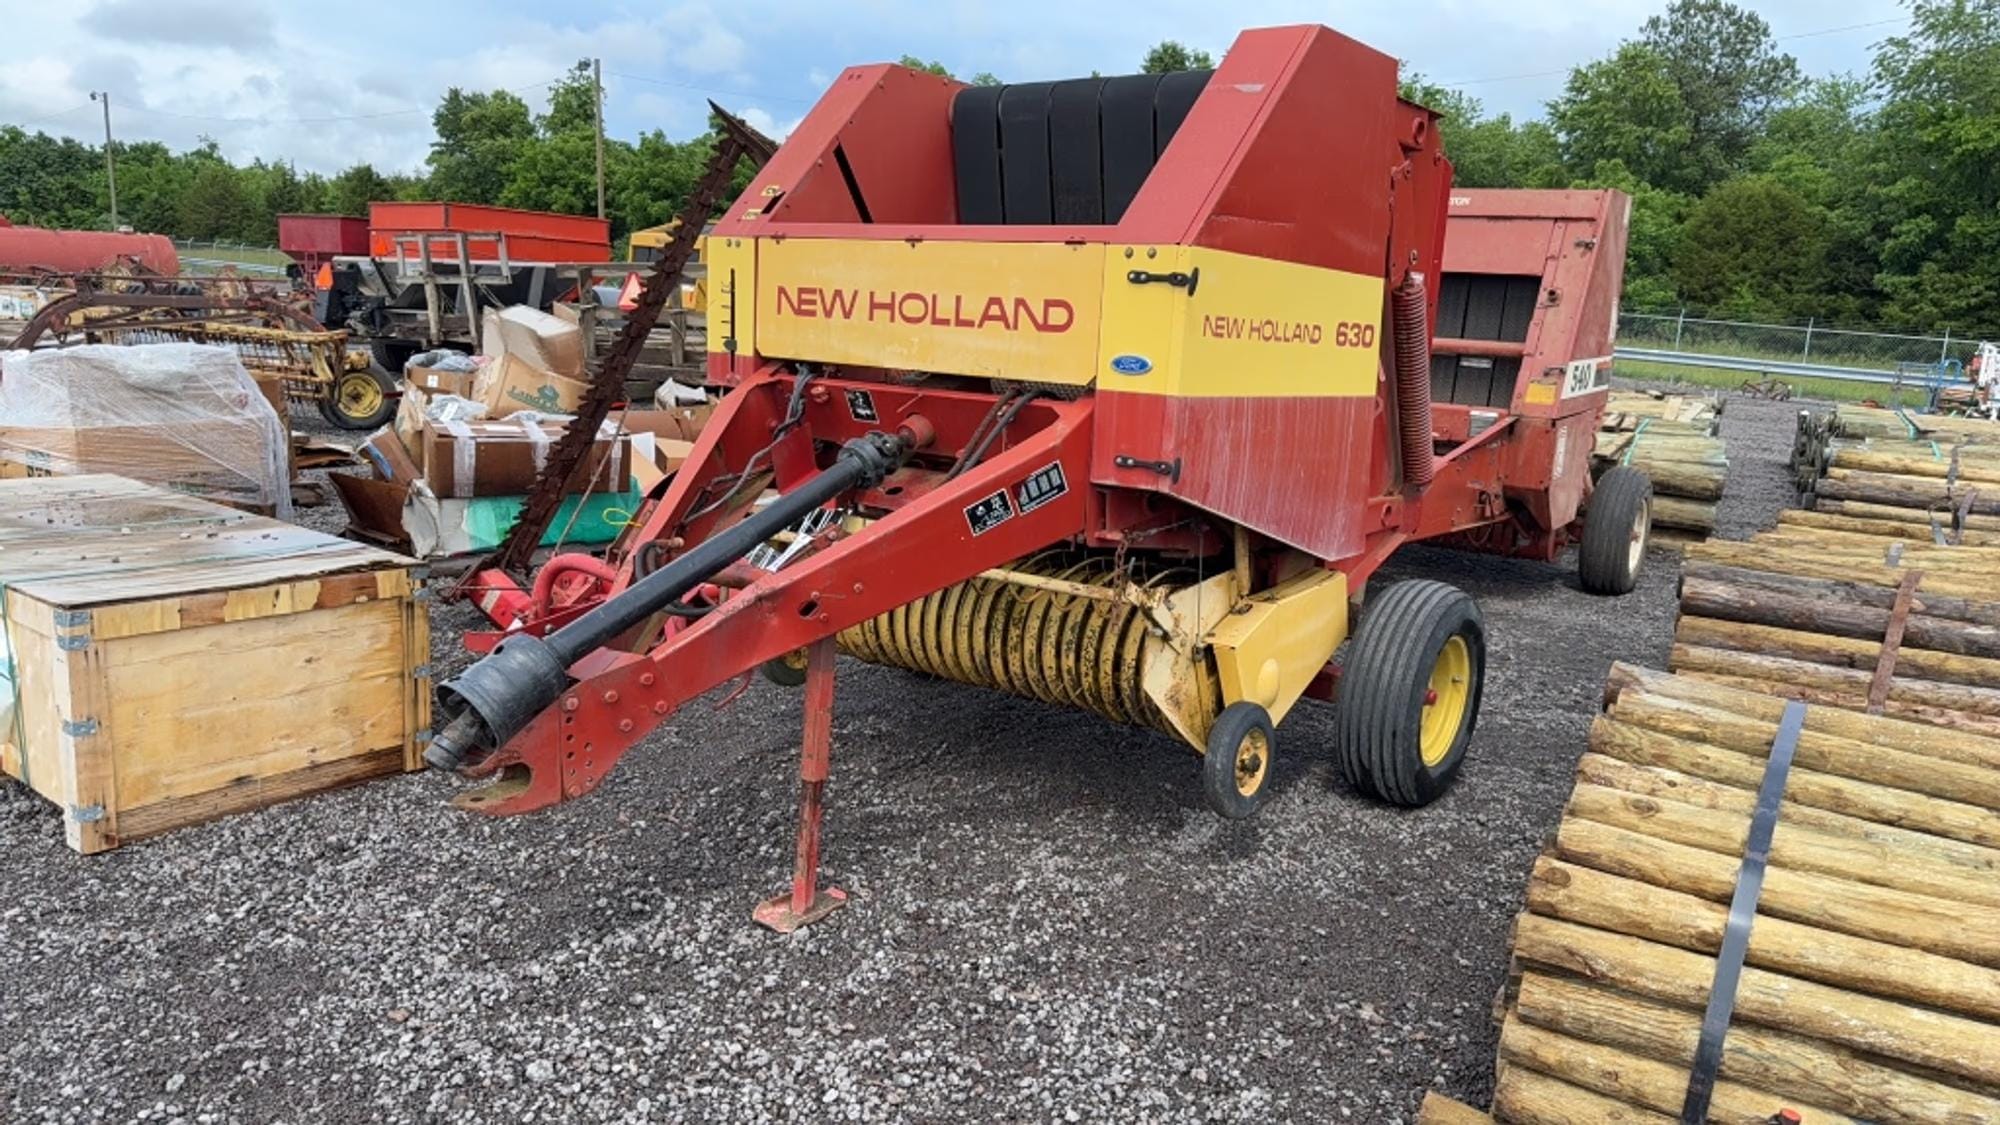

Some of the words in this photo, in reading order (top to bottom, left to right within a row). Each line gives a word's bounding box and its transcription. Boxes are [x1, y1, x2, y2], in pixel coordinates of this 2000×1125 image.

[776, 285, 859, 320] NEW
[868, 290, 1075, 333] HOLLAND
[1202, 314, 1246, 339] NEW
[1248, 318, 1322, 345] HOLLAND
[1335, 321, 1376, 349] 630
